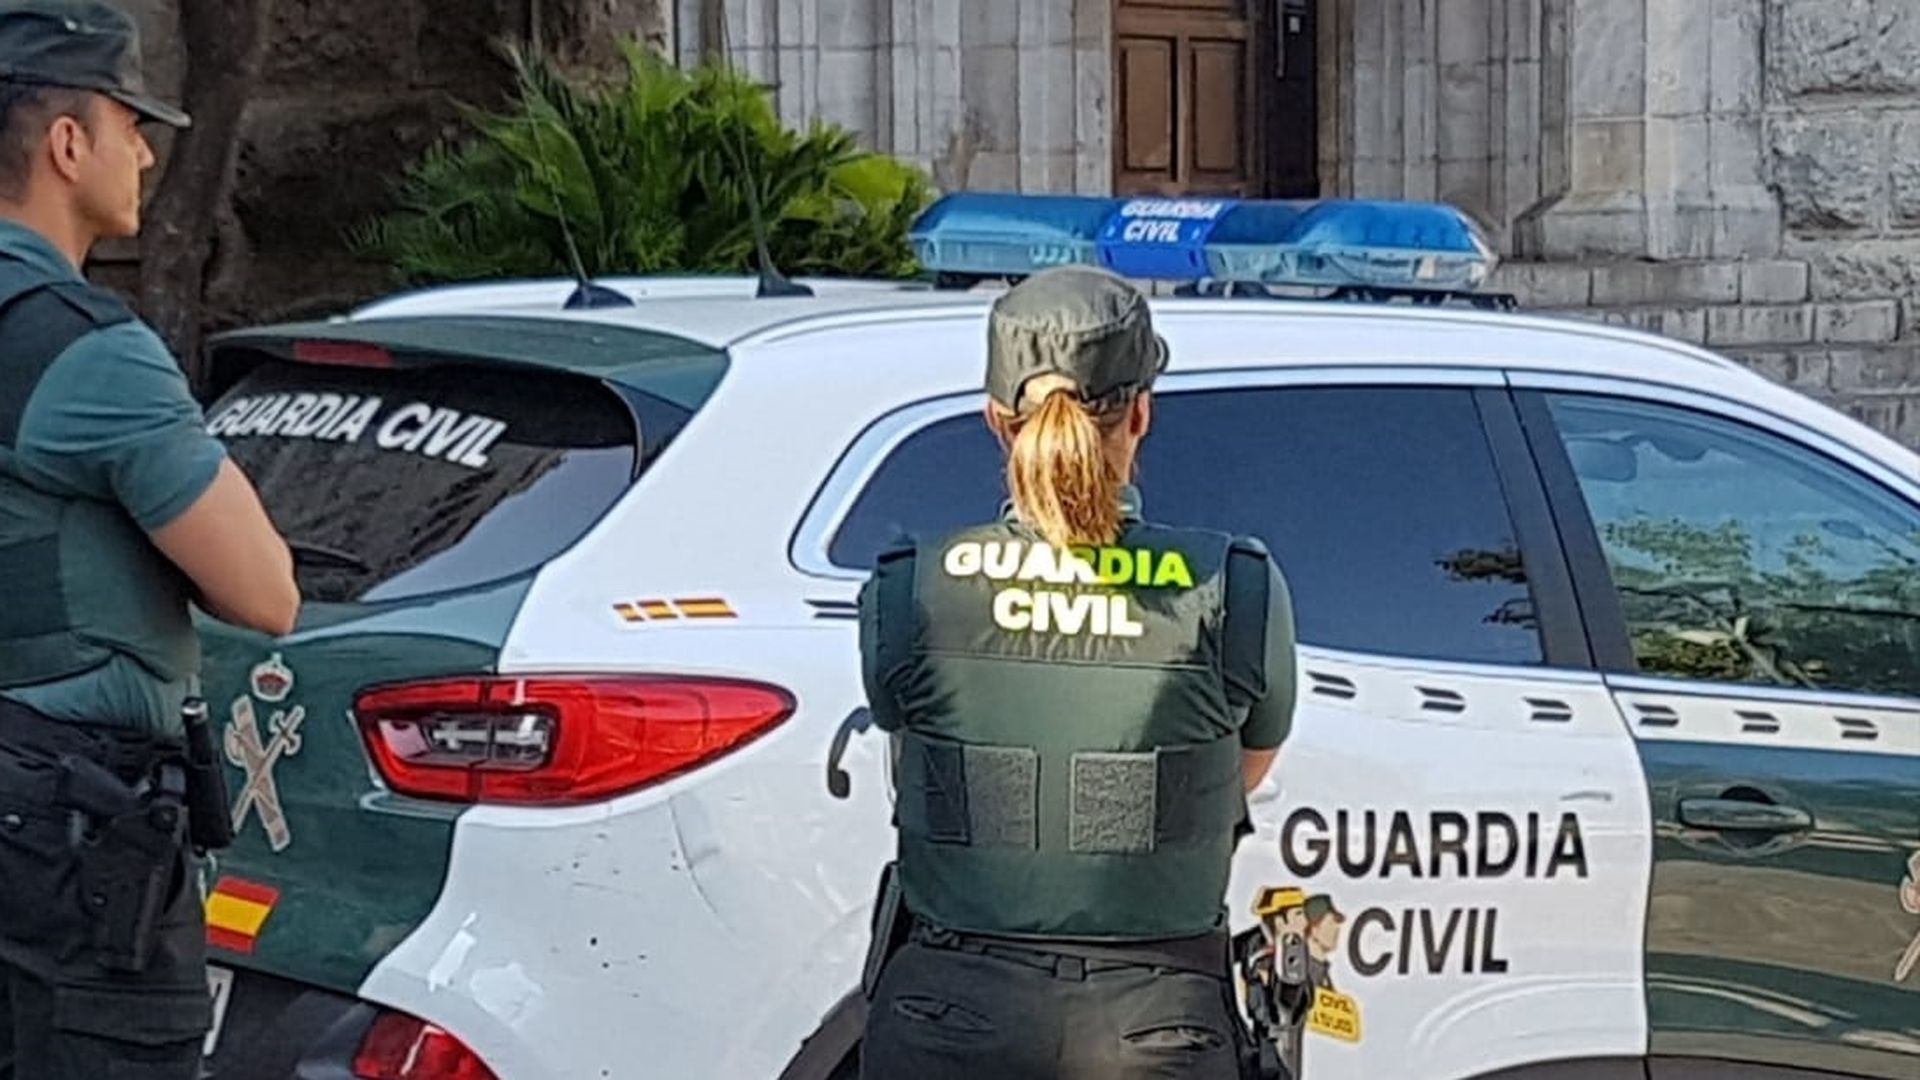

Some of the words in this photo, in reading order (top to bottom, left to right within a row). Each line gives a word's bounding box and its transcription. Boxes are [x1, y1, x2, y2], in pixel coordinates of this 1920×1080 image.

[1121, 200, 1222, 219] GUARDIA
[1123, 220, 1181, 242] CIVIL
[206, 393, 381, 441] GUARDIA
[377, 403, 507, 467] CIVIL
[945, 542, 1193, 587] GUARDIA
[993, 588, 1143, 636] CIVIL
[1280, 807, 1588, 878] GUARDIA
[1348, 907, 1508, 977] CIVIL
